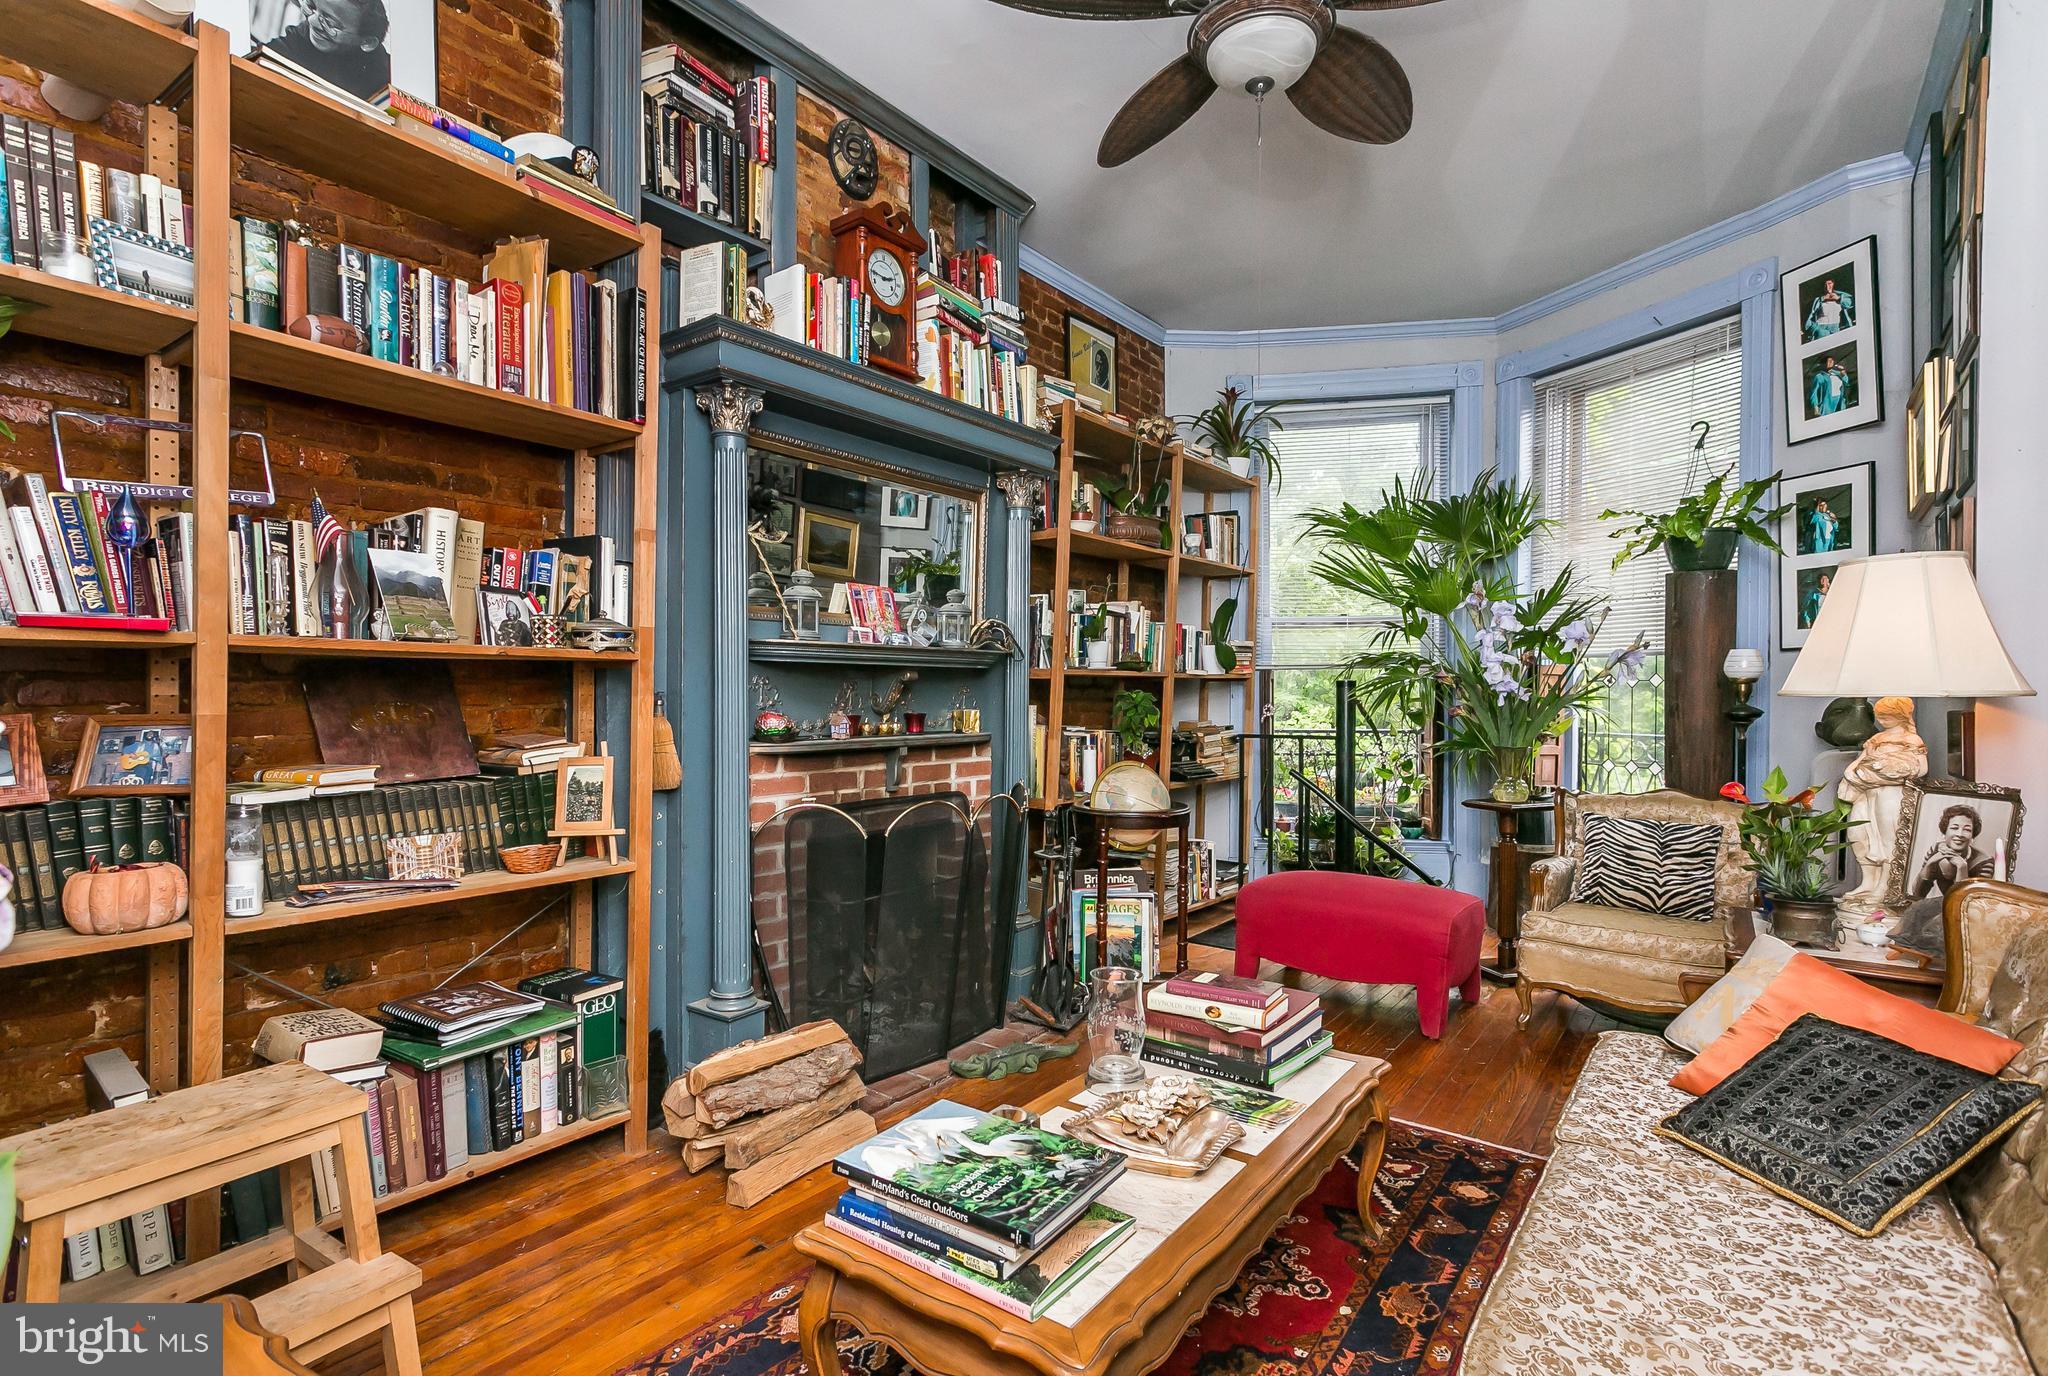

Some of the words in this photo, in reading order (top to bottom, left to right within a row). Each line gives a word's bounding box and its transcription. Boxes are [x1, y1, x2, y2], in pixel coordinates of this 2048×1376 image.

[14, 178, 26, 203] BLACK
[38, 184, 50, 211] BLACK
[62, 192, 74, 216] BLACK
[16, 204, 30, 240] AMERICA
[352, 280, 365, 334] Streisand
[400, 304, 411, 338] HOME
[502, 304, 512, 360] Literature
[637, 372, 646, 401] MASTERS
[58, 495, 80, 528] KITTY
[66, 526, 90, 563] KELLEY
[436, 530, 447, 573] HISTORY
[457, 534, 480, 545] ART
[81, 580, 103, 610] ROYALS
[244, 610, 254, 633] THINK
[266, 770, 295, 780] GREAT
[1084, 875, 1134, 884] Brinnica
[583, 993, 616, 1014] GEO
[948, 1162, 994, 1194] Maryland's
[960, 1180, 986, 1200] Great
[972, 1174, 1014, 1203] Outdoors
[871, 1178, 910, 1200] Maryland's
[910, 1192, 932, 1210] Great
[932, 1200, 968, 1223] Outdoors
[849, 1208, 881, 1228] Residential
[882, 1220, 906, 1238] Housing
[914, 1232, 941, 1250] Interiors
